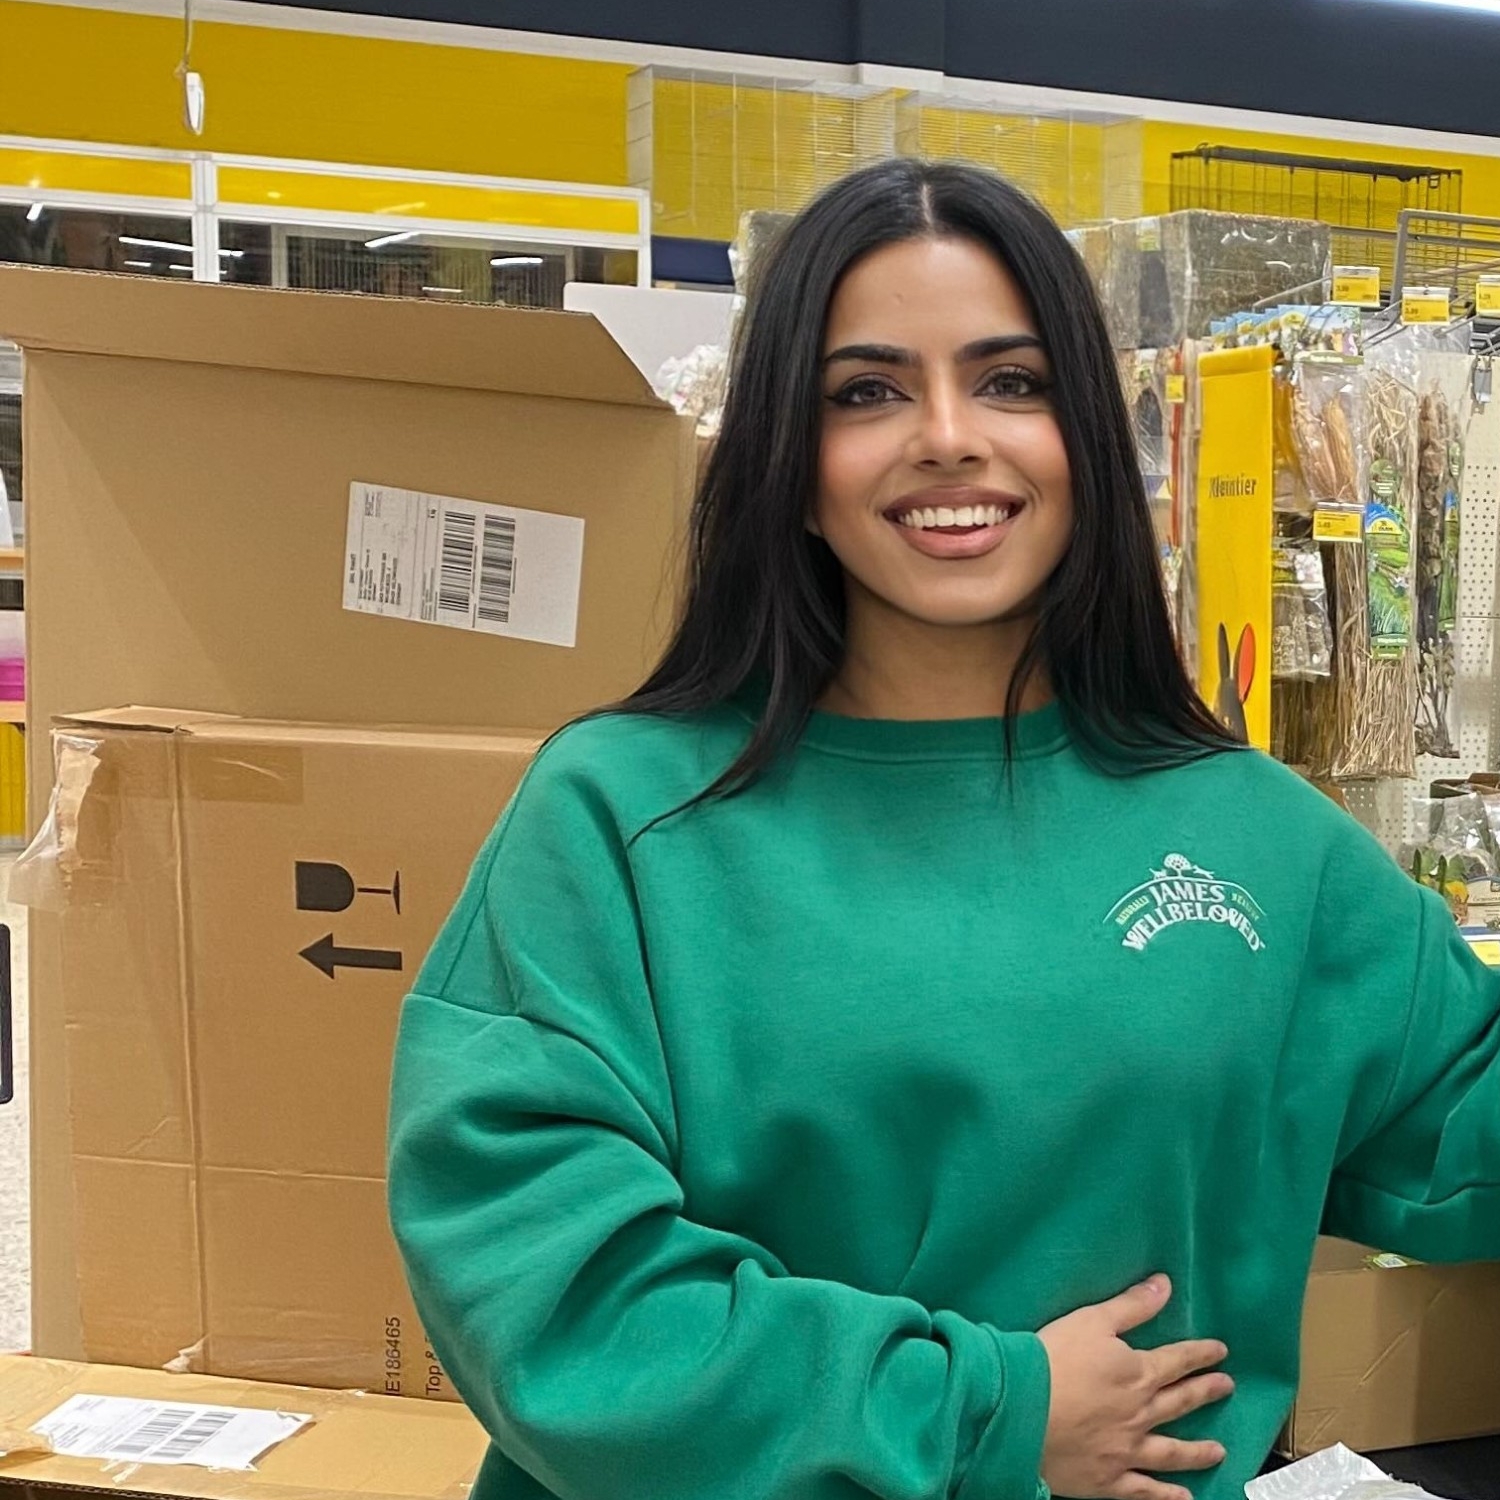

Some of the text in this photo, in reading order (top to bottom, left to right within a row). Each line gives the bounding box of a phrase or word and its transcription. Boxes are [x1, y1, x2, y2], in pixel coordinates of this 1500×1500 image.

[1209, 474, 1256, 499] Kleintier
[1149, 881, 1226, 907] JAMES
[1121, 902, 1261, 951] WELLBELOVED
[385, 1315, 401, 1396] E186465
[425, 1365, 443, 1395] Top
